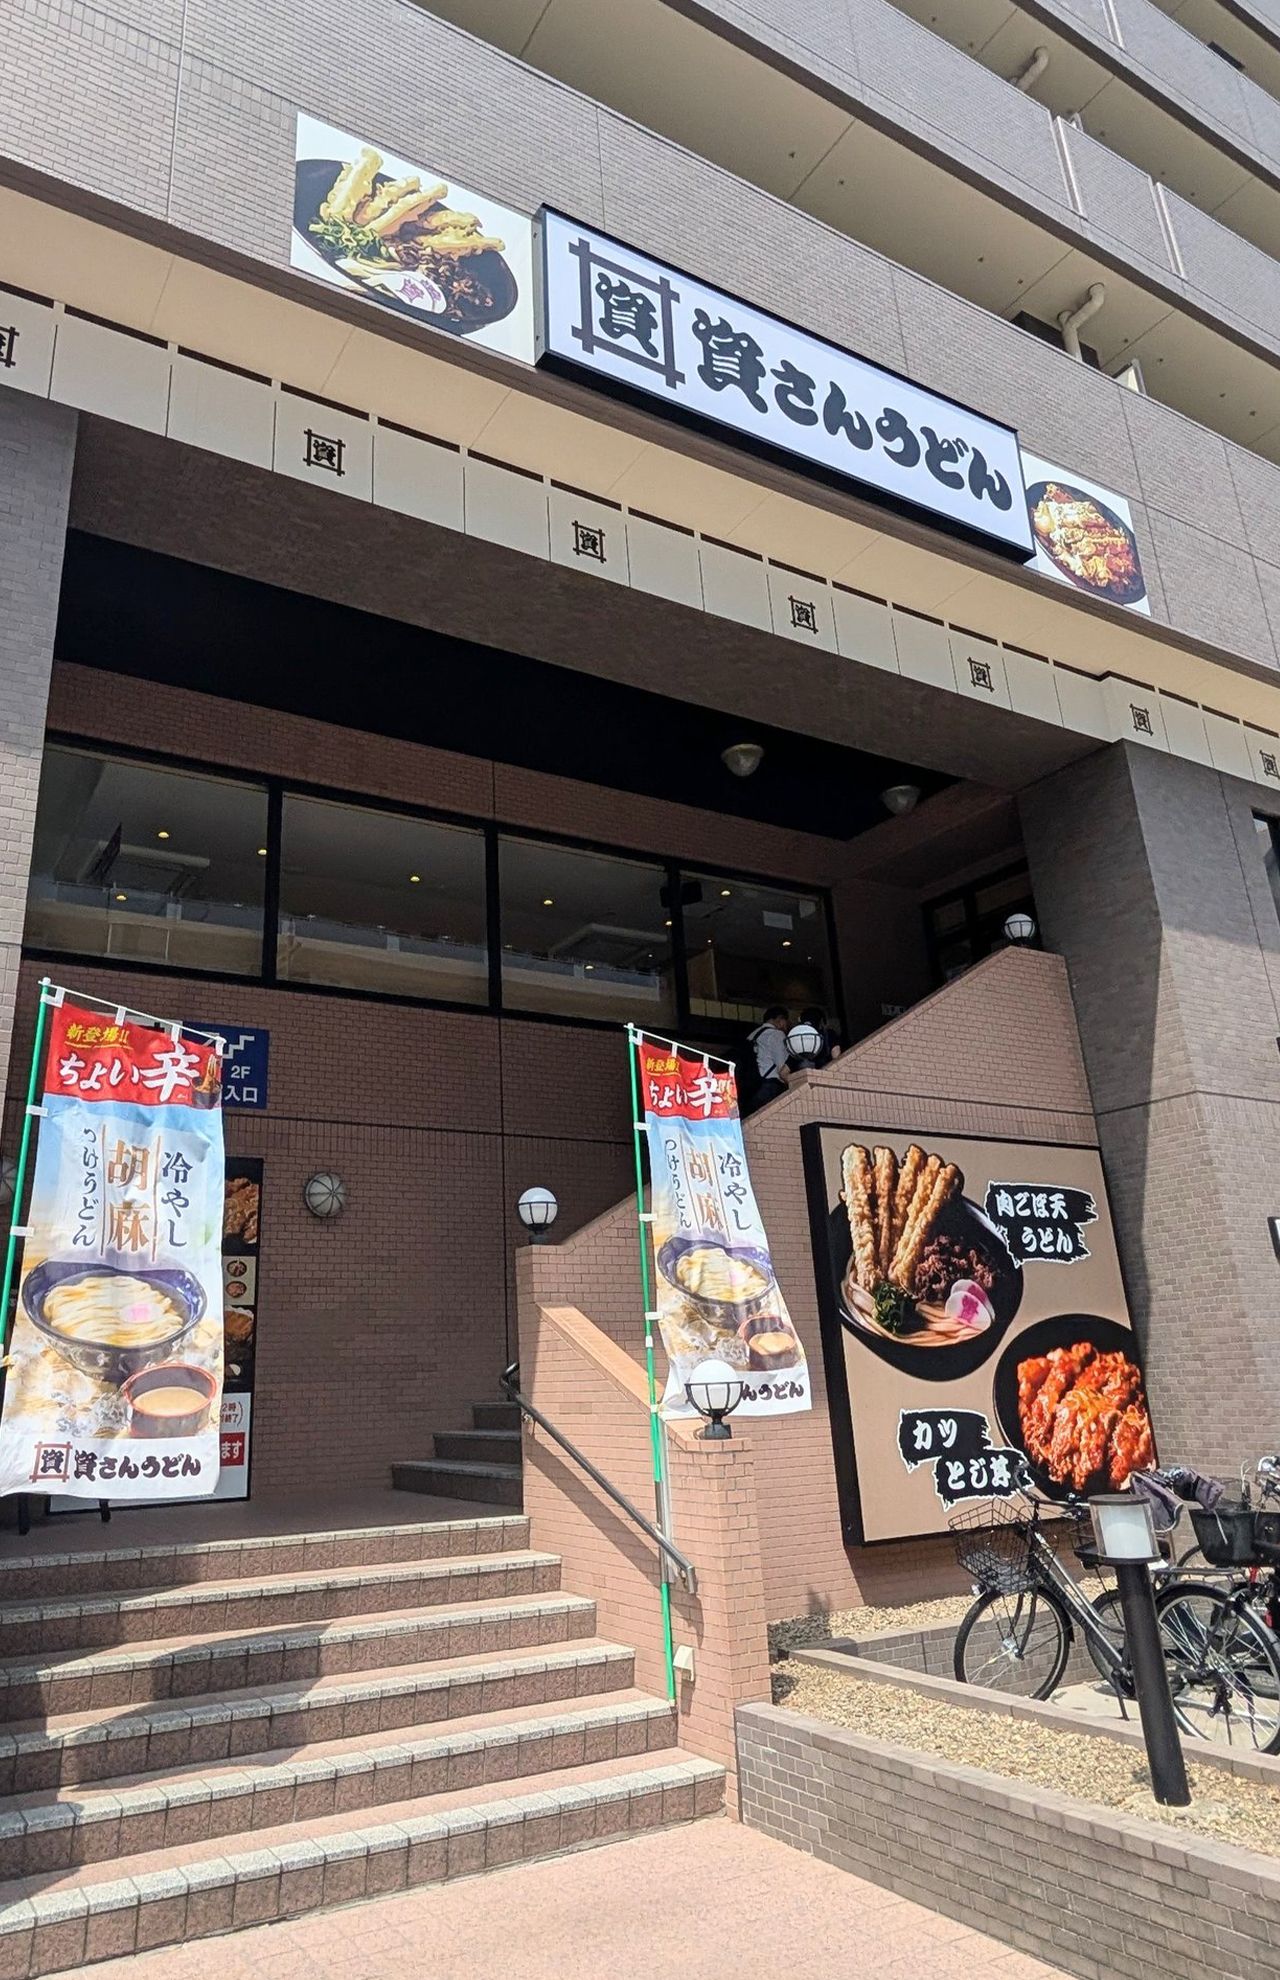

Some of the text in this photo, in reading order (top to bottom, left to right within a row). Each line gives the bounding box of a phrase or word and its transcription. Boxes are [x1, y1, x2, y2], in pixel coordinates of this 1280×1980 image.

[691, 307, 1012, 511] 資さんうどん
[59, 1044, 200, 1102] ちょい辛
[224, 1085, 258, 1103] 入口
[230, 1065, 251, 1079] 2F
[649, 1069, 723, 1117] ちょい辛
[72, 1128, 98, 1247] つけうどん
[107, 1139, 150, 1252] 胡麻
[161, 1151, 193, 1247] 冷やし
[665, 1139, 692, 1229] つけうどん
[687, 1147, 725, 1232] 胡麻
[718, 1152, 752, 1230] 冷やし
[995, 1189, 1068, 1220] 肉ごぼ天
[1021, 1226, 1073, 1254] うどん
[741, 1380, 804, 1400] んうどん
[913, 1418, 958, 1450] カツ
[74, 1449, 201, 1481] 資さんうどん
[945, 1454, 1012, 1490] とじ丼
